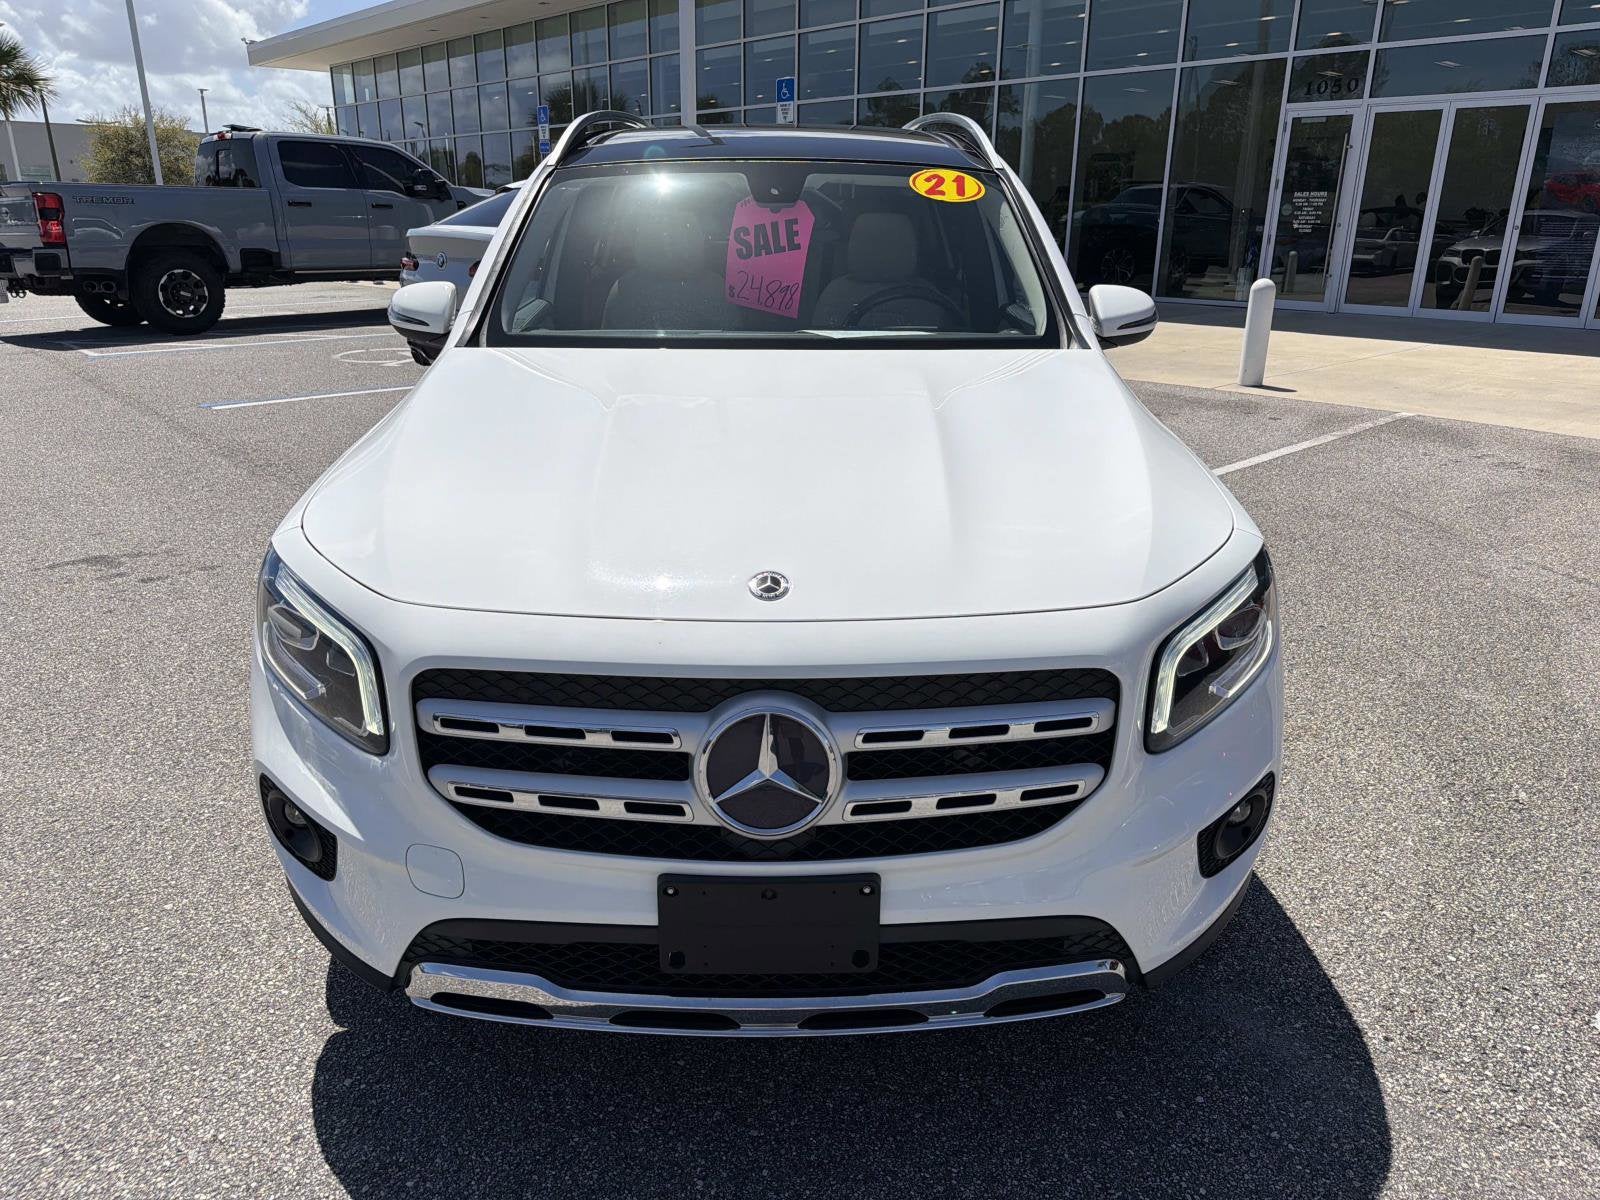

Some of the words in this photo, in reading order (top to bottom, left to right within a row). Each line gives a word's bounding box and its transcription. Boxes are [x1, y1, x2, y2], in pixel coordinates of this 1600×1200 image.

[1304, 79, 1359, 95] 1050
[924, 174, 965, 197] 21
[734, 218, 801, 260] SALE
